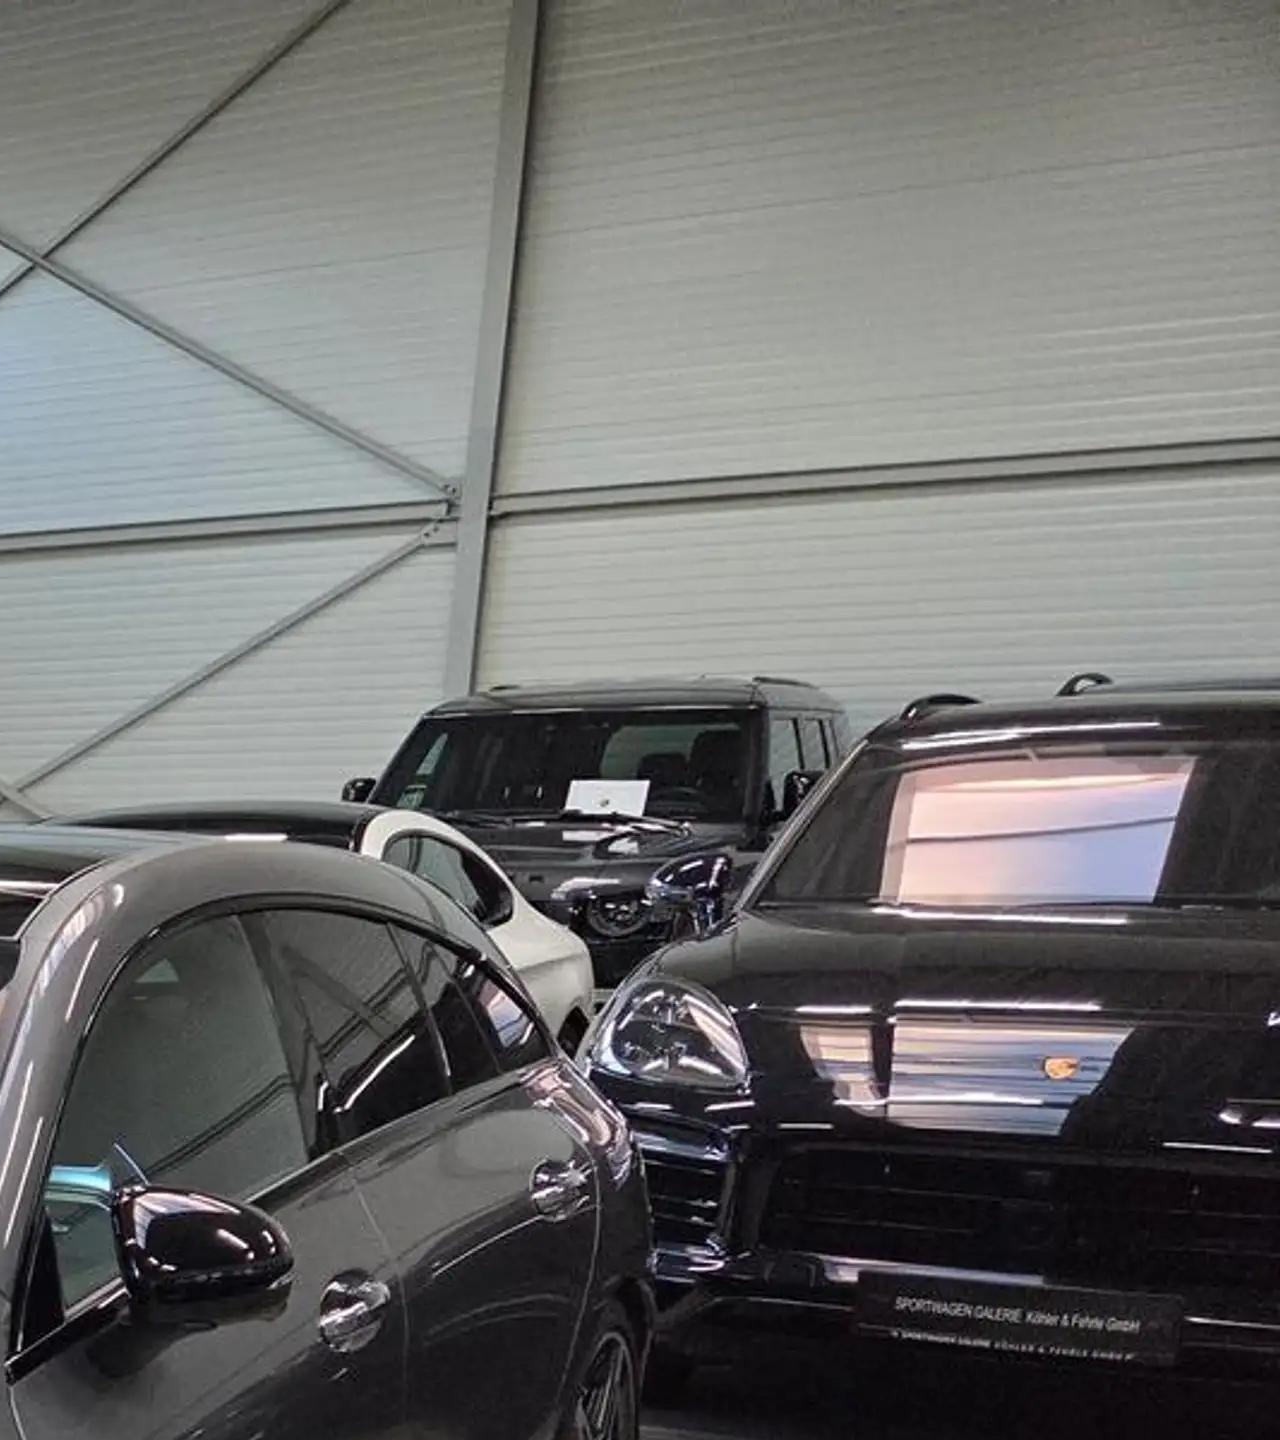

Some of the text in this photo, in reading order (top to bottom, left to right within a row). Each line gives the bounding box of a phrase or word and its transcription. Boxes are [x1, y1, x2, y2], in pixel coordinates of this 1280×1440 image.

[895, 1295, 973, 1318] SPORTWAGEN
[975, 1305, 1022, 1324] GALERIE
[1061, 1313, 1069, 1328] &
[1105, 1316, 1140, 1334] GmbH
